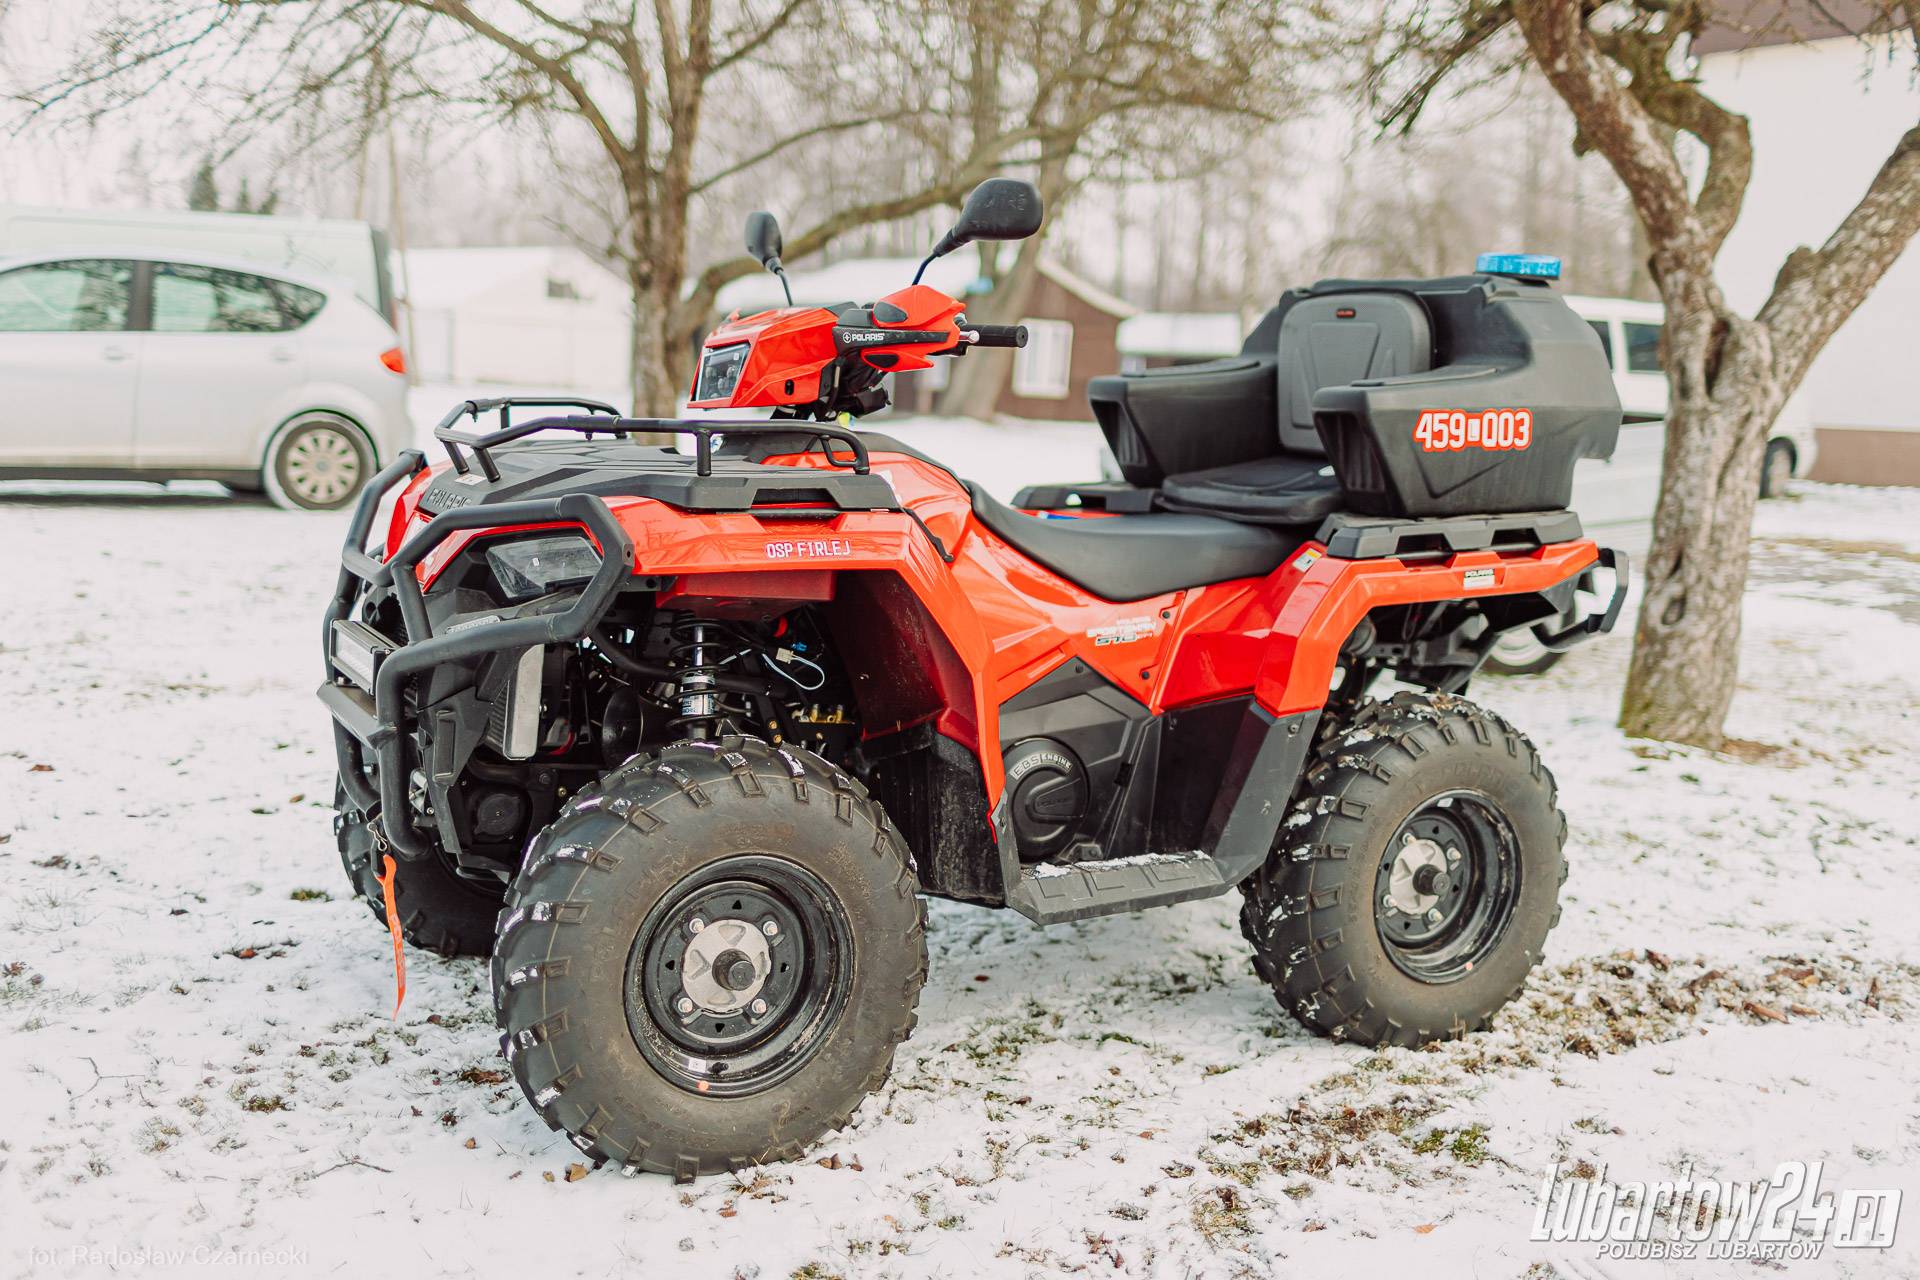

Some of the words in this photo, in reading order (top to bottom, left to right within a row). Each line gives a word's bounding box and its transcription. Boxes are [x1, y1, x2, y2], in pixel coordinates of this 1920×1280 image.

[852, 332, 885, 341] POLARIS
[766, 542, 793, 559] OSP
[797, 540, 851, 557] FIRLEJ
